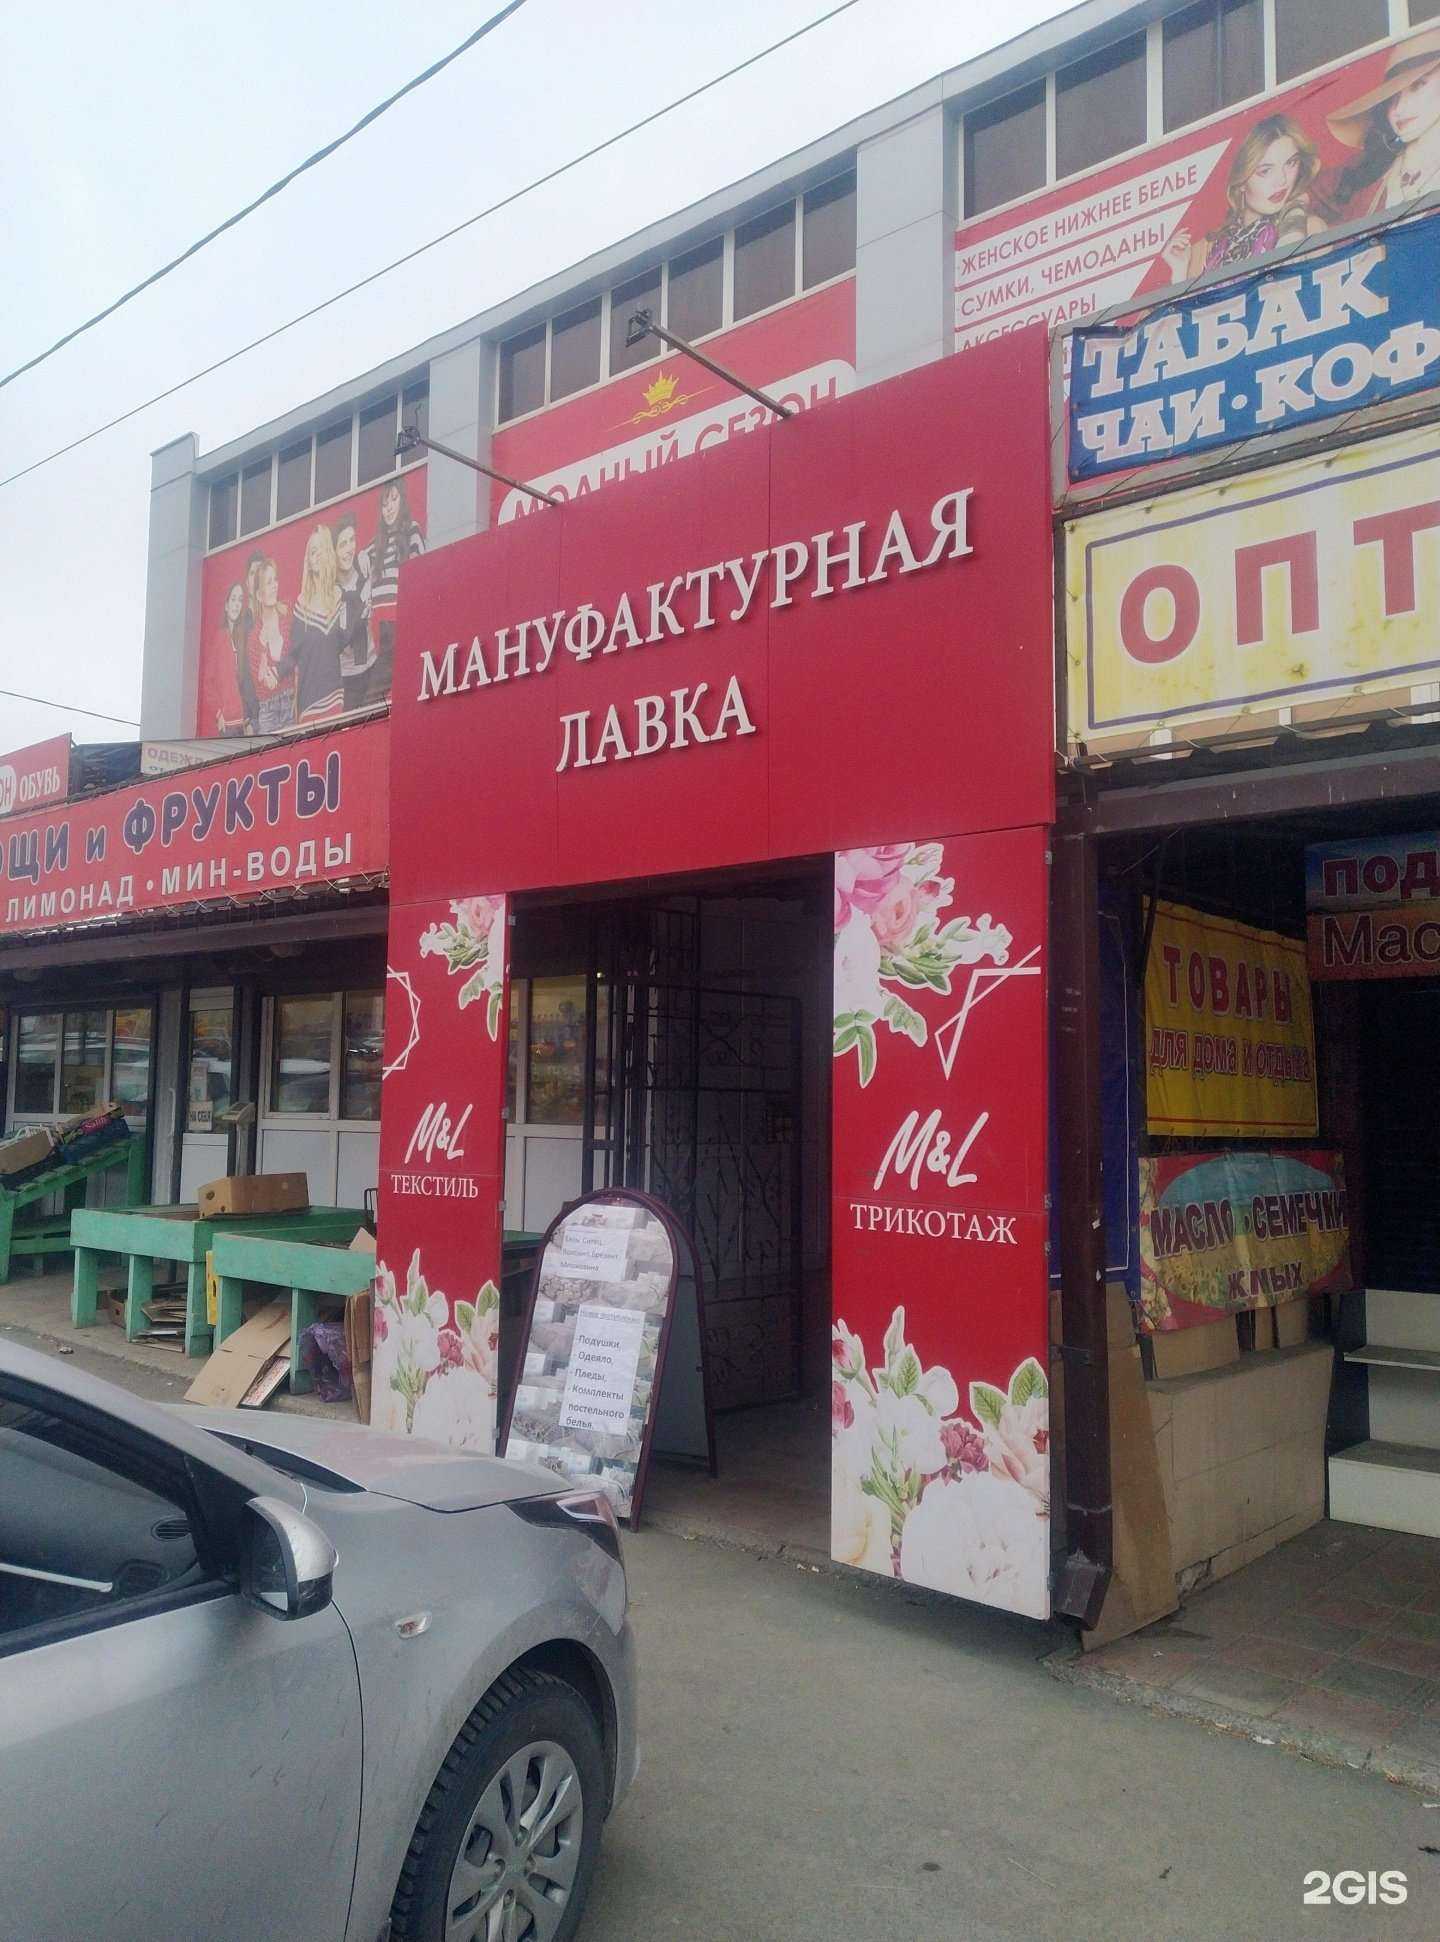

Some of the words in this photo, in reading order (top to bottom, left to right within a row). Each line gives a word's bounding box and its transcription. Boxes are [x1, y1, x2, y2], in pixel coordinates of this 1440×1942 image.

[960, 224, 1049, 276] ЖЕНСКОЕ
[1053, 194, 1132, 244] НИЖНЕЕ
[1138, 163, 1198, 208] БЕЛЬЕ
[960, 275, 1035, 317] СУМКИ,
[1041, 223, 1166, 285] ЧЕМОДАНЫ
[1082, 244, 1389, 399] ТАБАК
[416, 487, 975, 702] МАНУФАКТУРНАЯ
[555, 675, 756, 772] ЛАВКА
[0, 822, 70, 886] ЩИ
[123, 750, 341, 855] ФРУКТЫ
[20, 766, 61, 802] ОБУВЬ
[5, 875, 135, 923] ЛИМОНАД
[161, 832, 352, 896] МИН-ВОДЫ
[404, 1101, 474, 1165] M&L
[873, 1108, 990, 1191] M&L
[390, 1174, 479, 1199] ТЕКСТИЛЬ
[850, 1203, 1019, 1245] ТРИКОТАЖ
[1151, 1197, 1236, 1260] МАСЛО
[568, 1403, 625, 1419] постельного
[572, 1384, 624, 1400] Комплекты
